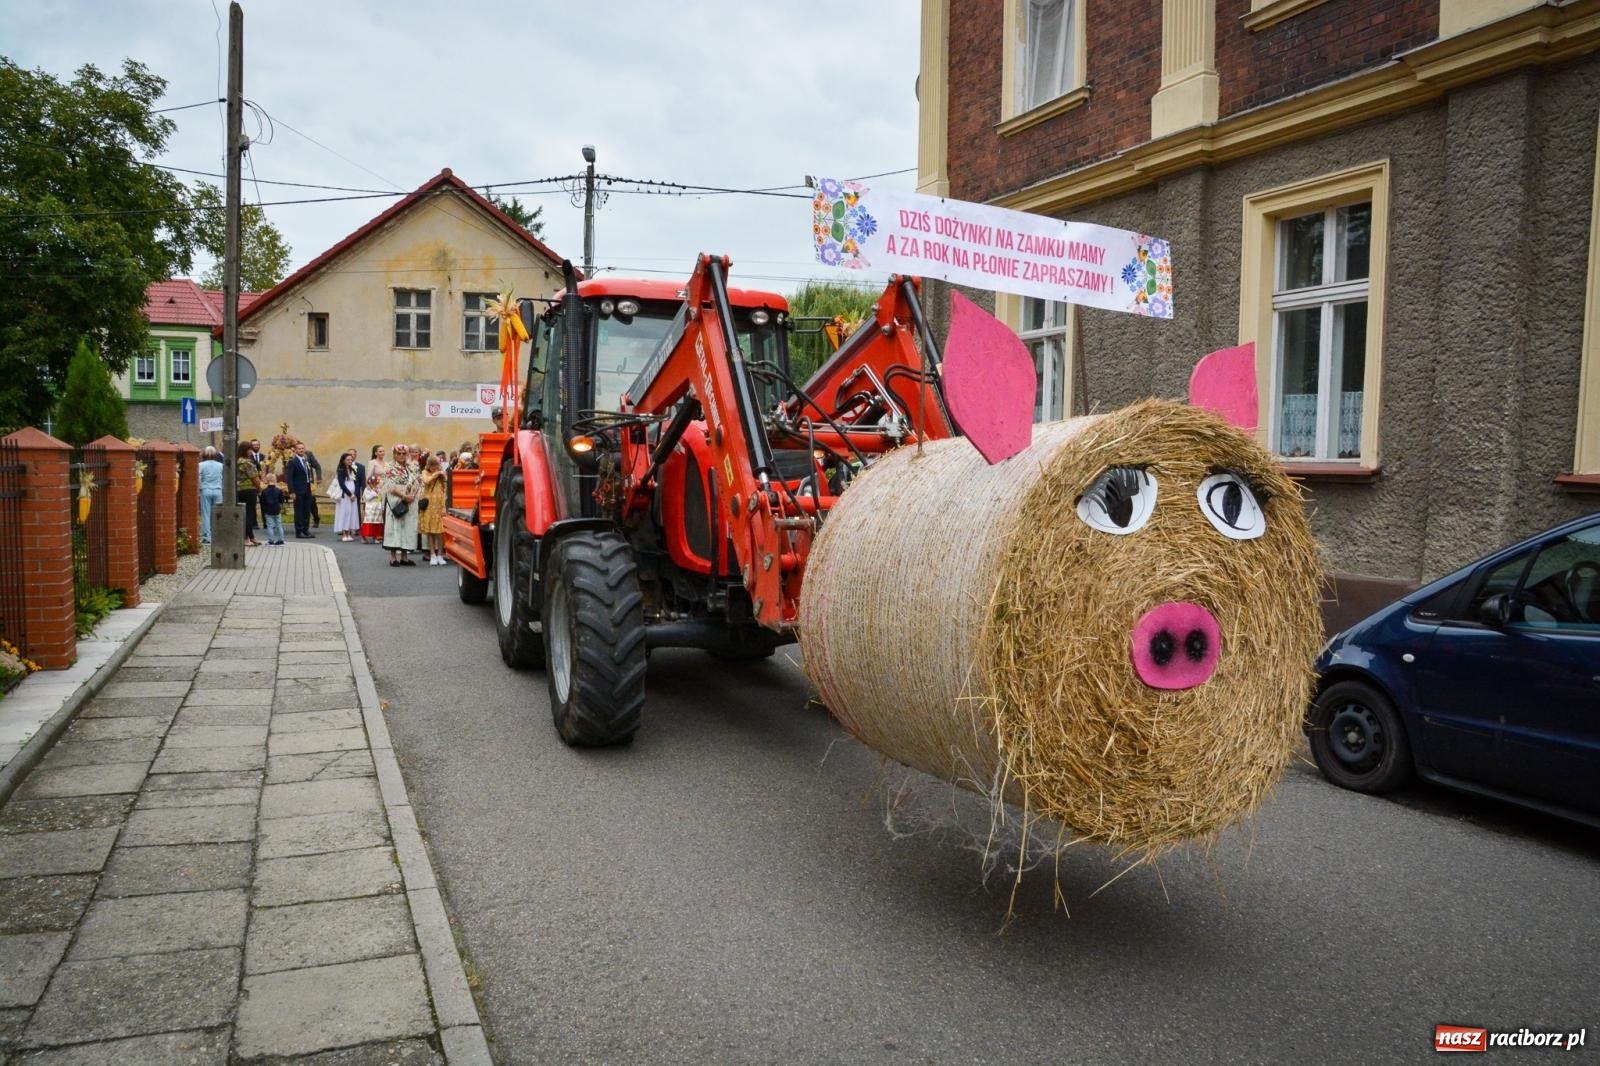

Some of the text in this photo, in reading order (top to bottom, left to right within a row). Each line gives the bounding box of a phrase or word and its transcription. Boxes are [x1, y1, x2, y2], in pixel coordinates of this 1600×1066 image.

[887, 234, 896, 254] A
[900, 237, 919, 257] ZA
[923, 243, 949, 264] ROK
[952, 248, 969, 268] NA
[973, 252, 1018, 278] PŁONIE
[1023, 261, 1108, 292] ZAPRASZAMY
[900, 208, 1106, 266] DZIŚ DOŻYNKI NA ZAMKU MAMY
[450, 405, 482, 414] Brzezie
